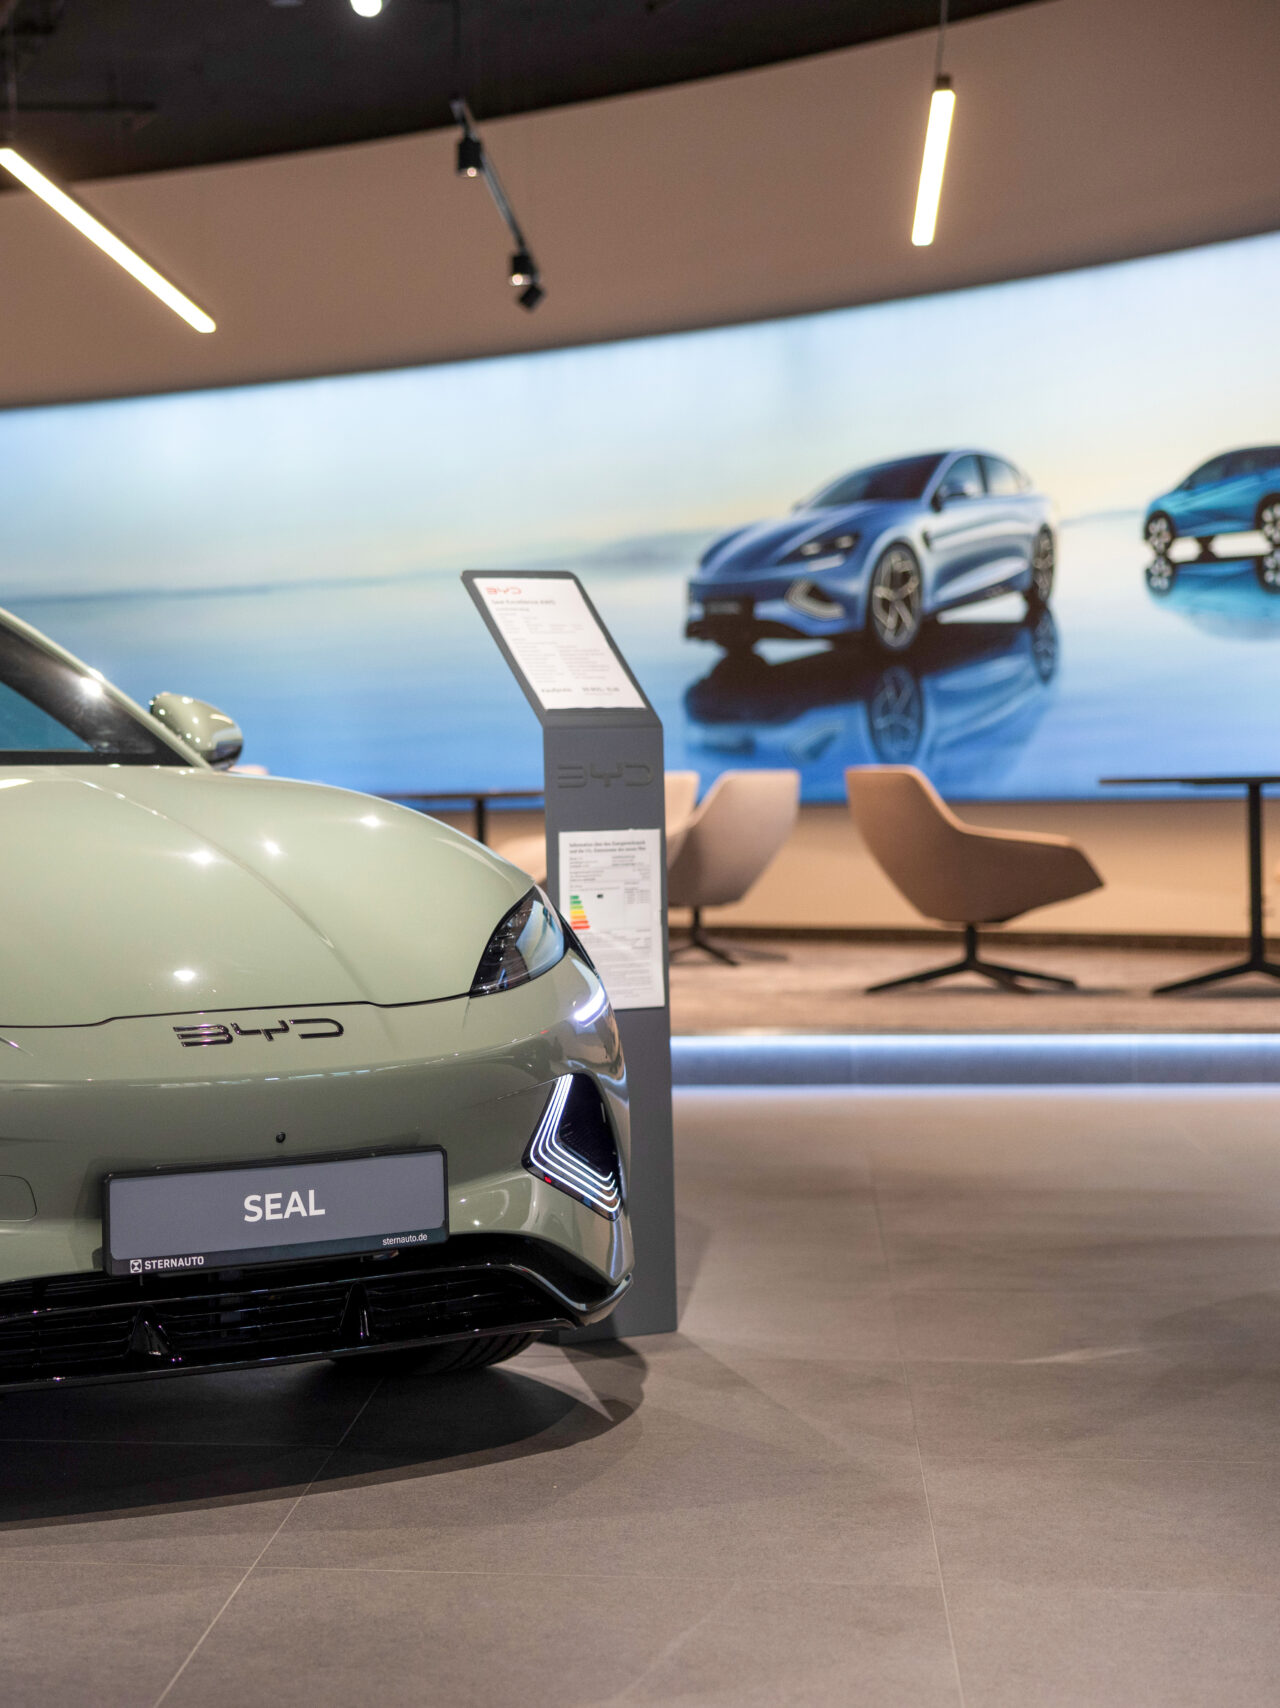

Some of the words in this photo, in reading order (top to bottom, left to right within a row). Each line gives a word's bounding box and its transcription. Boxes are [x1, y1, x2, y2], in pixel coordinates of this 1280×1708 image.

[486, 586, 522, 595] BYD
[557, 762, 654, 789] BYD
[173, 1018, 345, 1047] BYD
[243, 1189, 326, 1223] SEAL
[382, 1233, 428, 1246] sternauto.de
[144, 1256, 205, 1270] STERNAUTO
